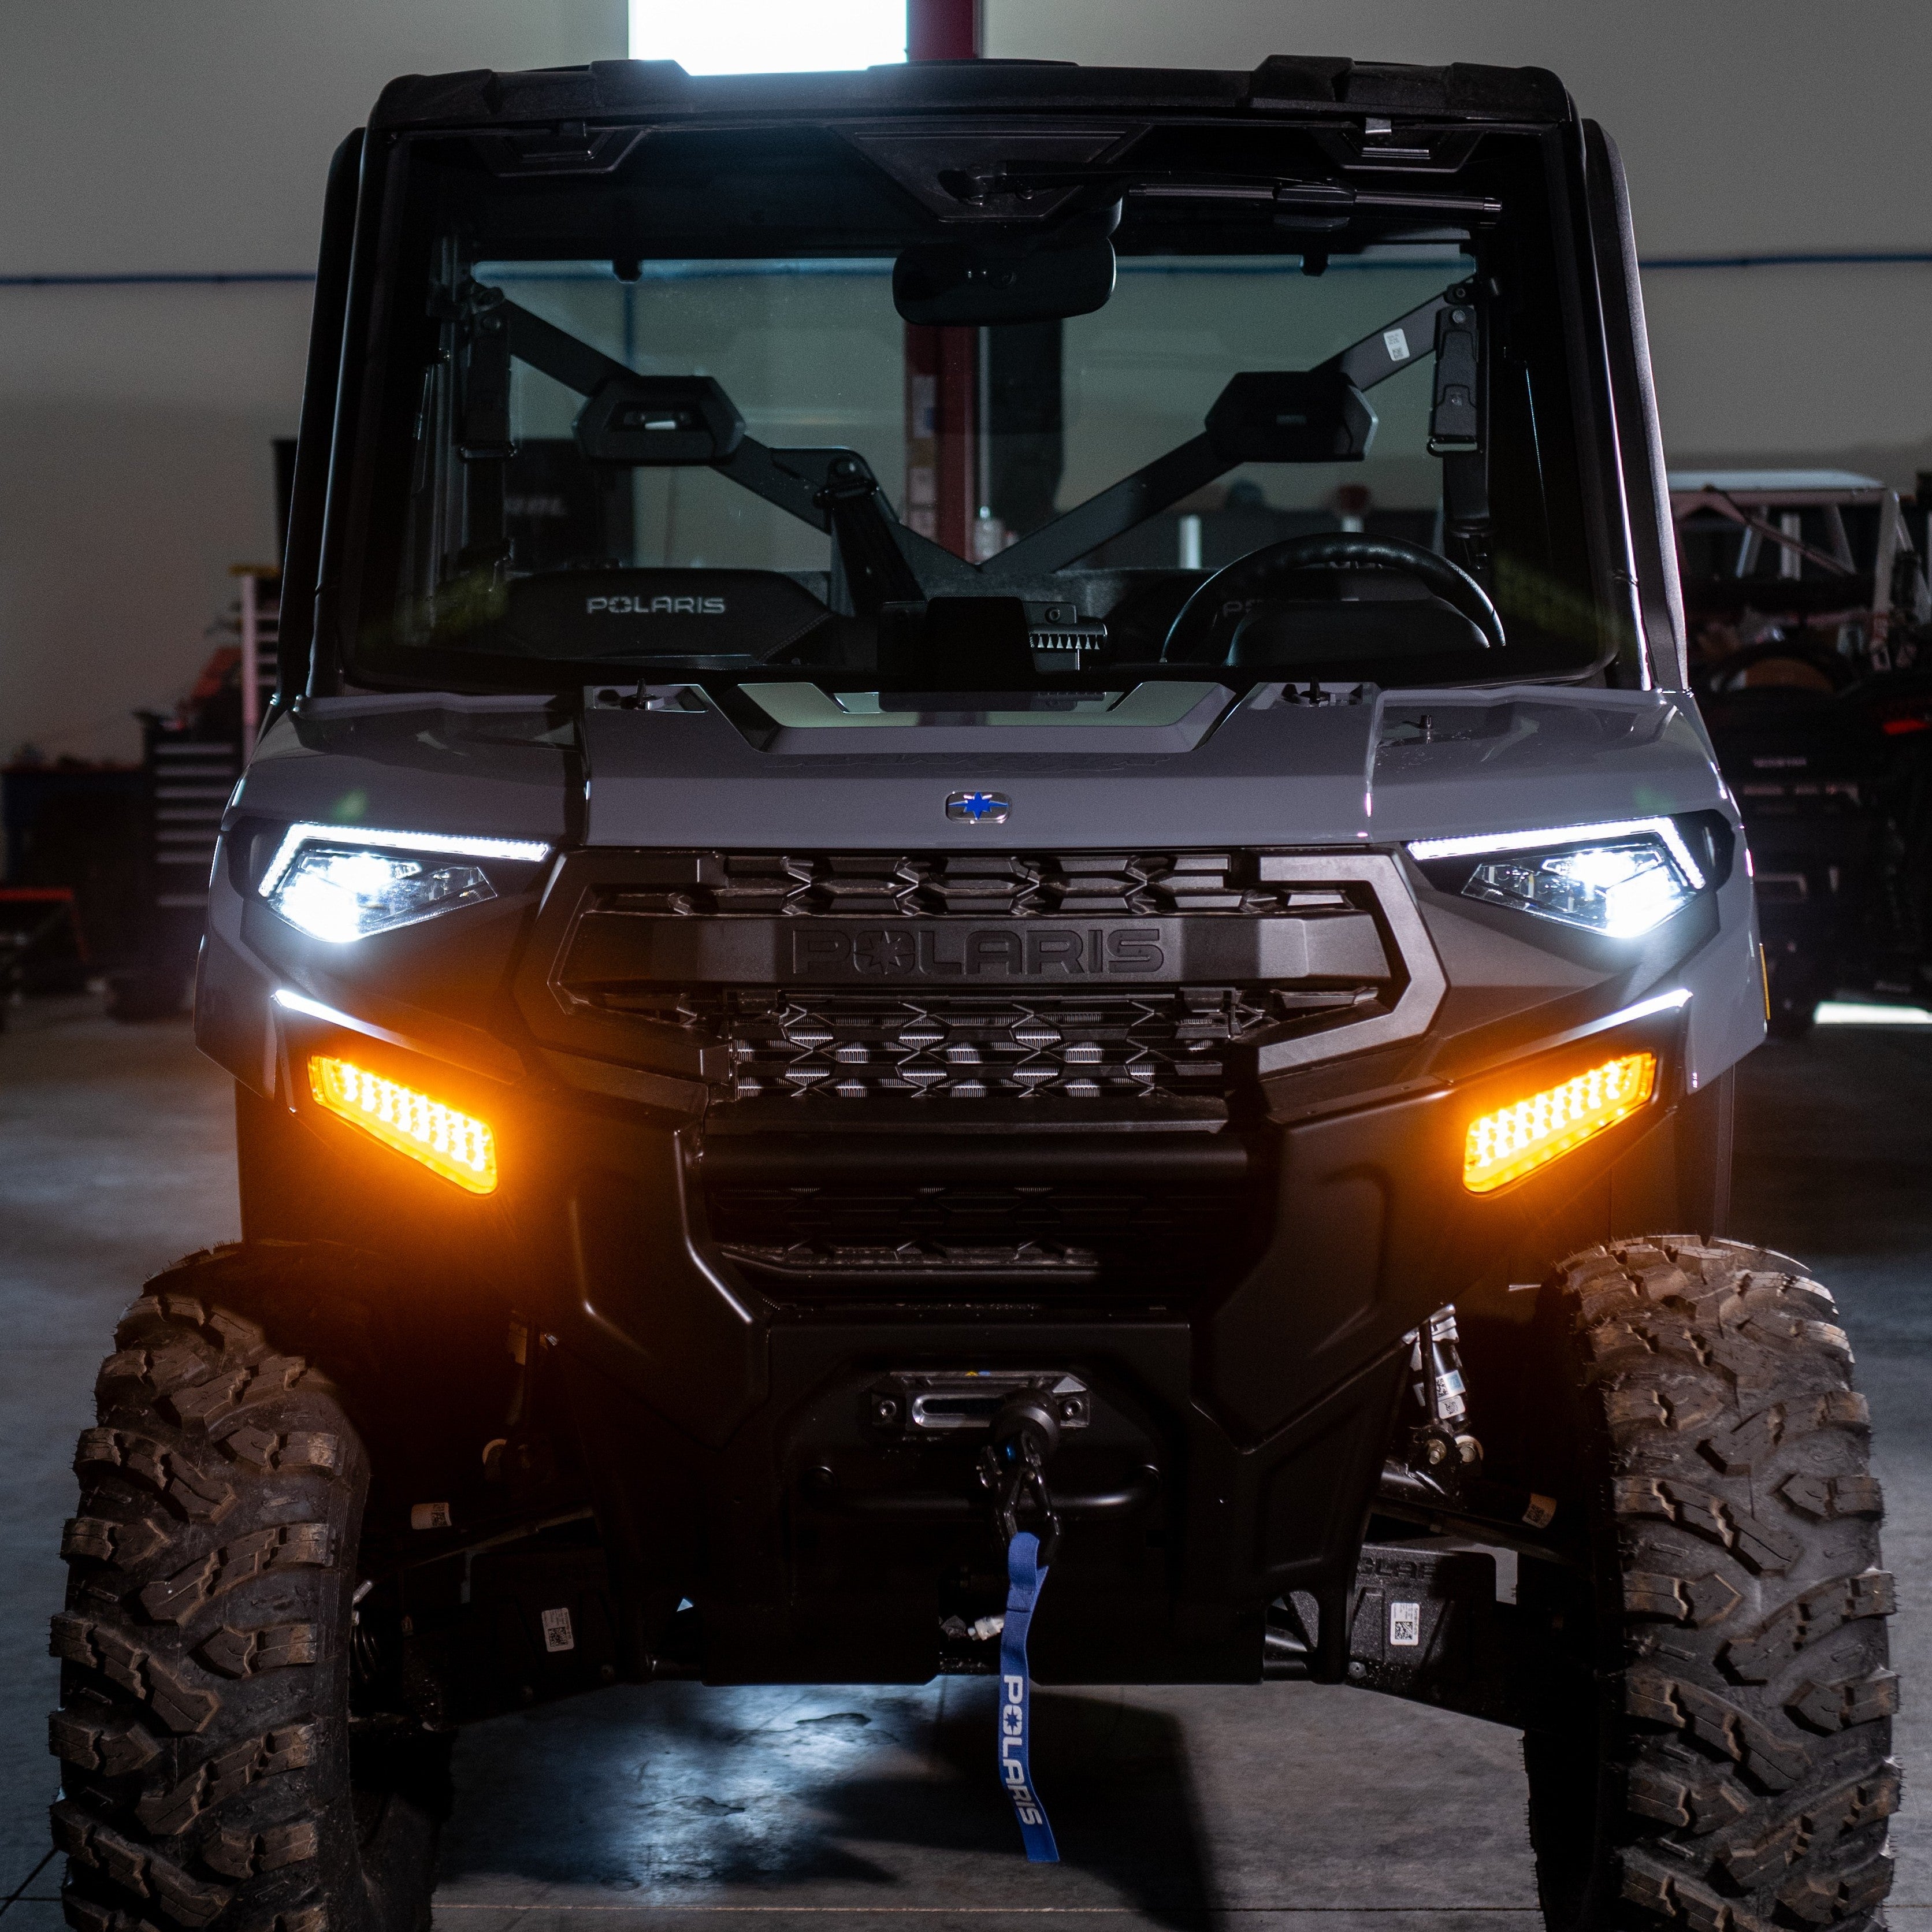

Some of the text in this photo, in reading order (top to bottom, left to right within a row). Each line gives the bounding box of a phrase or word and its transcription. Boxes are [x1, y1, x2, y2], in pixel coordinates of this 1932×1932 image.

[586, 595, 726, 614] POLARIS
[792, 928, 1165, 975] POLARIS
[1002, 1674, 1043, 1825] POLARIS
